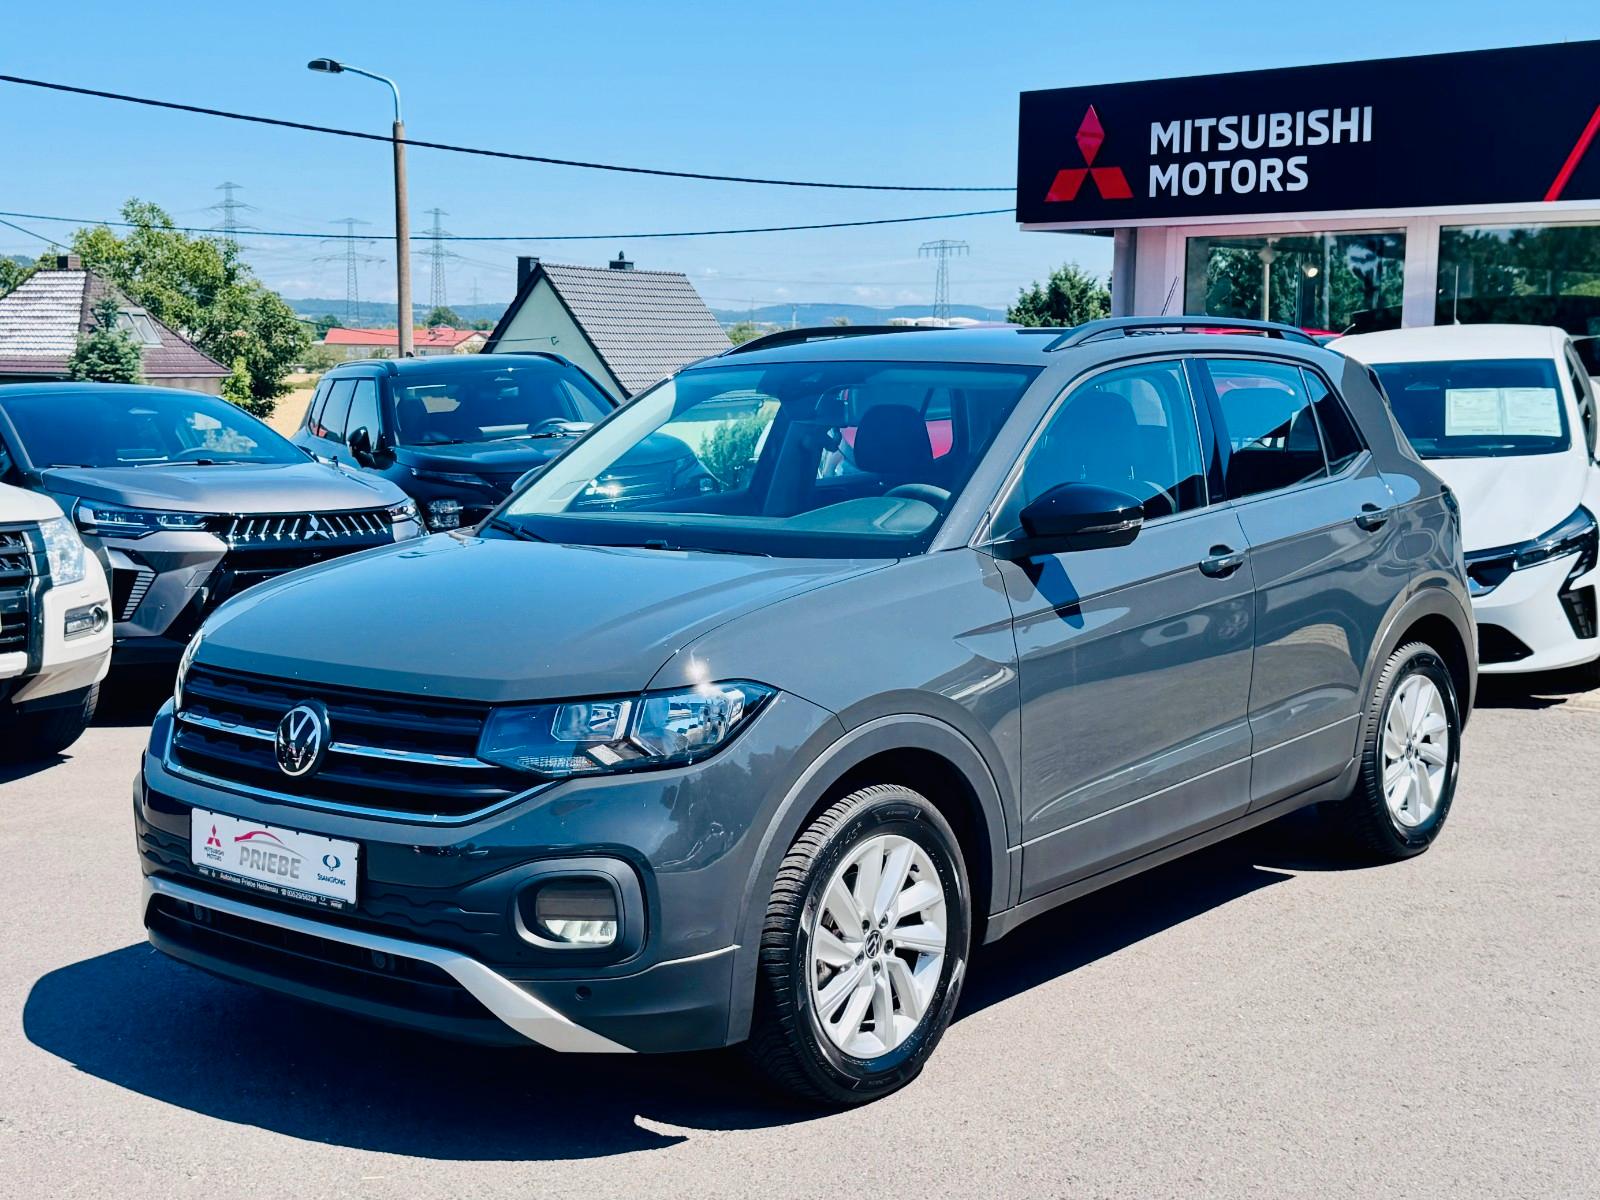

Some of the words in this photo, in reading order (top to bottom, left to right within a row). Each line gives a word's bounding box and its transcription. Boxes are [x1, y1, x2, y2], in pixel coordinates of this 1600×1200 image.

[1150, 106, 1373, 155] MITSUBISHI
[1149, 156, 1309, 198] MOTORS
[239, 846, 302, 879] PRIEBE
